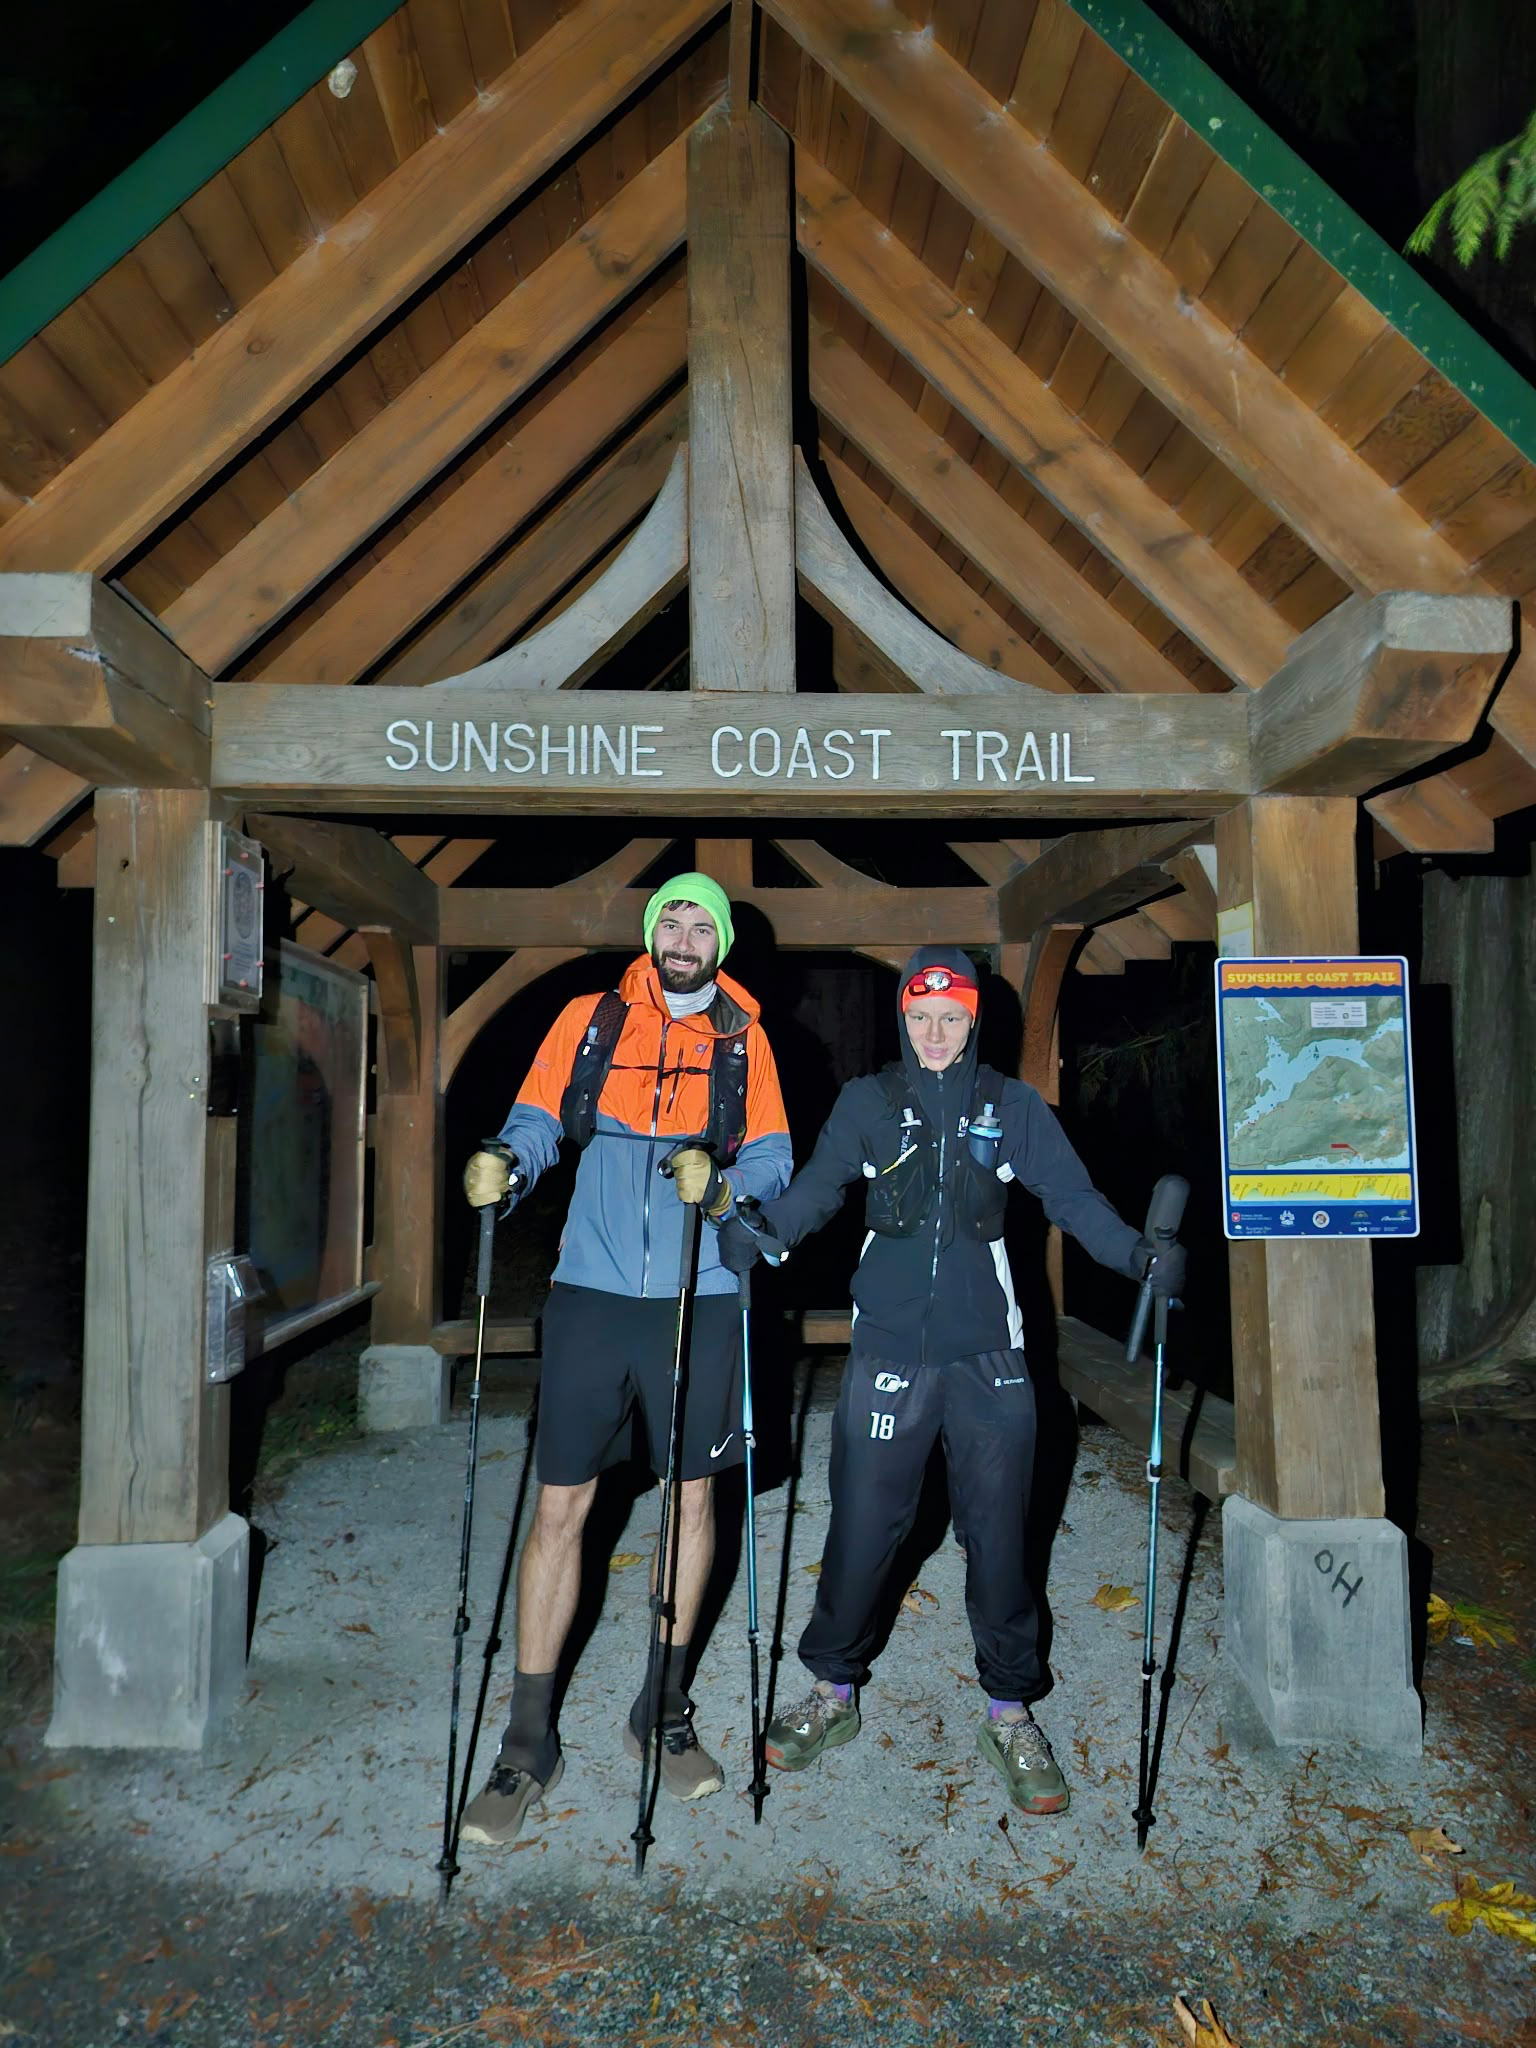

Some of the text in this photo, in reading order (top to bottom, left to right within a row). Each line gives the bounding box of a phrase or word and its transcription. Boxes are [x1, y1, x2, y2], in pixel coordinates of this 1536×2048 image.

[385, 719, 1096, 783] SUNSHINE COAST TRAIL
[1227, 971, 1396, 984] SUNSHINE COAST TRAIL
[869, 1411, 895, 1440] 18
